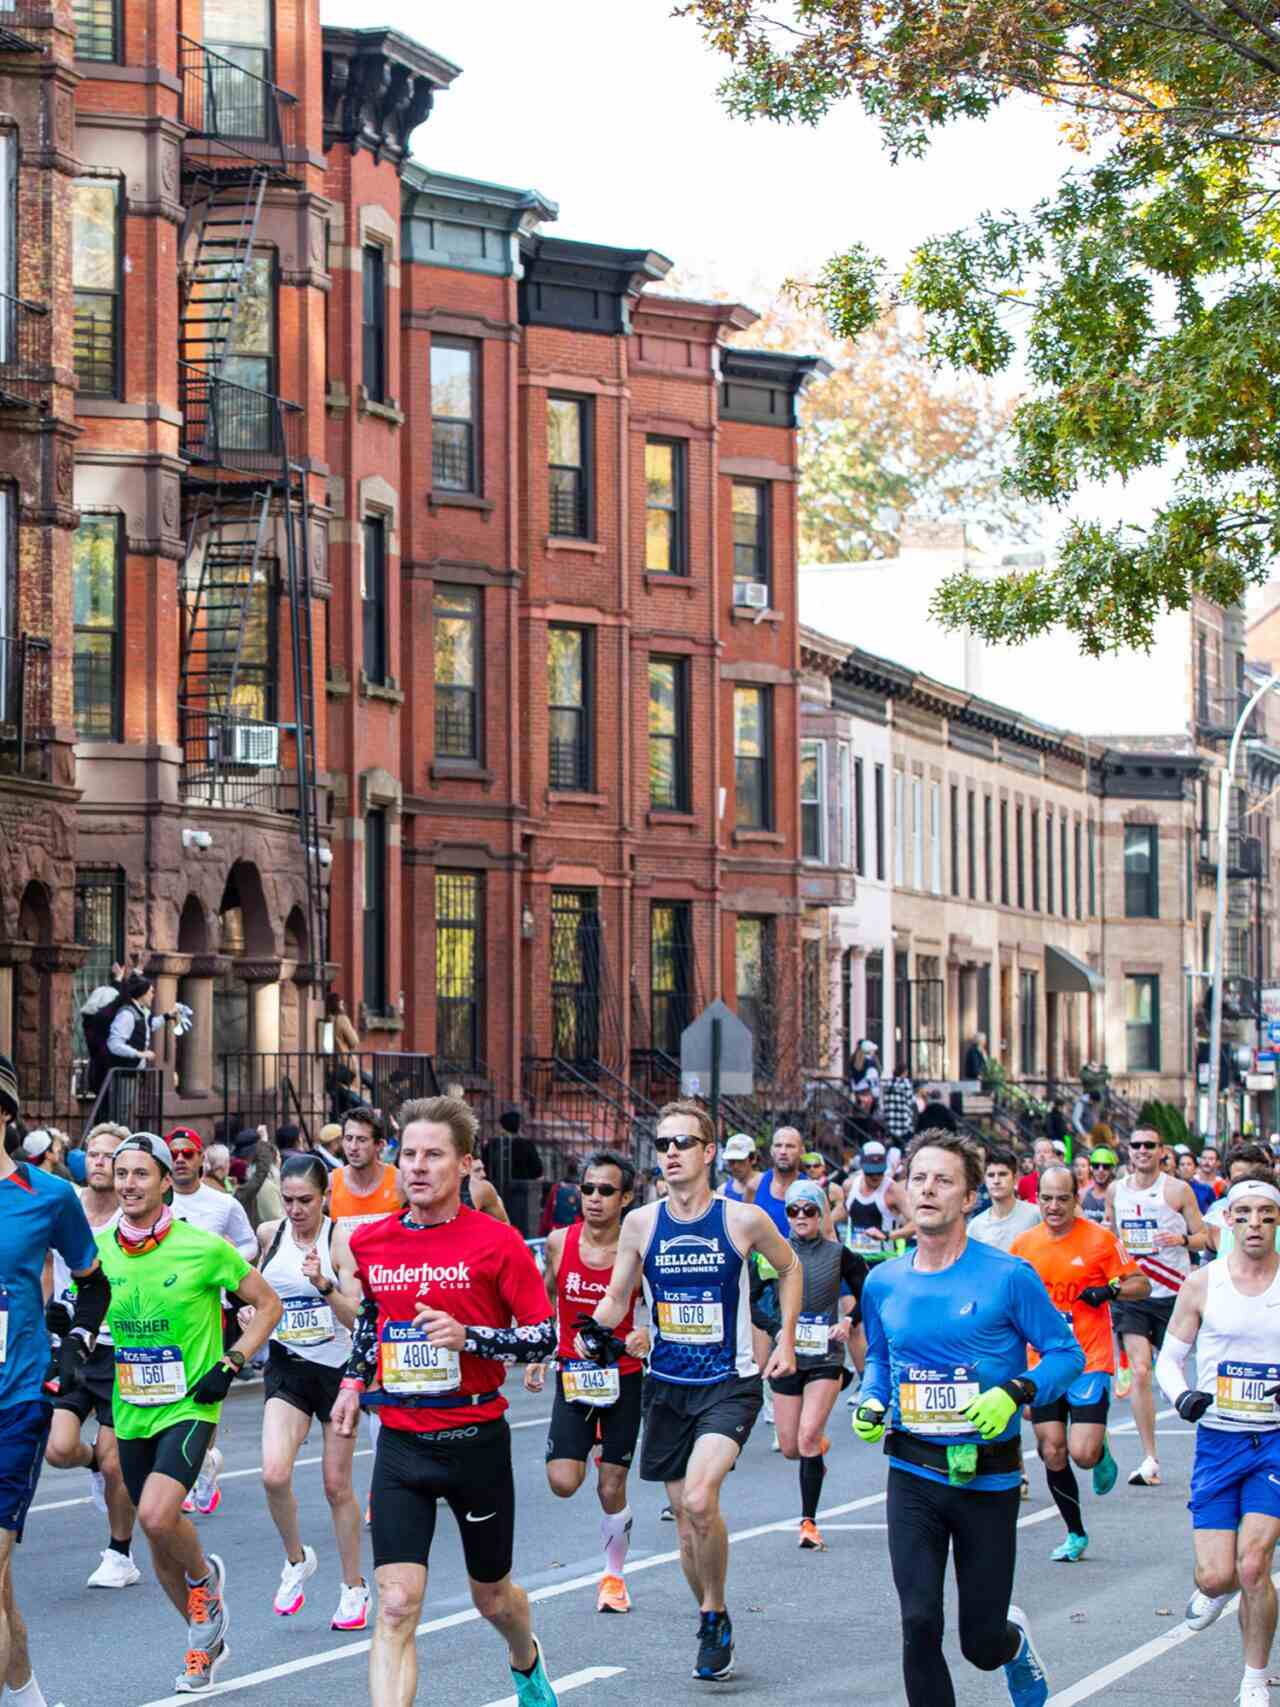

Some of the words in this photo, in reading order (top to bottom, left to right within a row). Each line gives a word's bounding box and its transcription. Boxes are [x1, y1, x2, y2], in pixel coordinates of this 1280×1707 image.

[655, 1252, 726, 1267] HELLGATE
[368, 1261, 470, 1284] Kinderhook
[660, 1266, 681, 1274] ROAD
[291, 1310, 318, 1329] 2075
[678, 1305, 705, 1324] 1678
[113, 1319, 170, 1334] FINISHER
[388, 1325, 407, 1340] tcs
[403, 1343, 439, 1368] 4803
[141, 1364, 166, 1385] 1561
[581, 1371, 605, 1388] 2143
[908, 1367, 928, 1381] tcs
[924, 1386, 957, 1410] 2150
[1241, 1381, 1265, 1401] 1410
[436, 1425, 479, 1441] PRO
